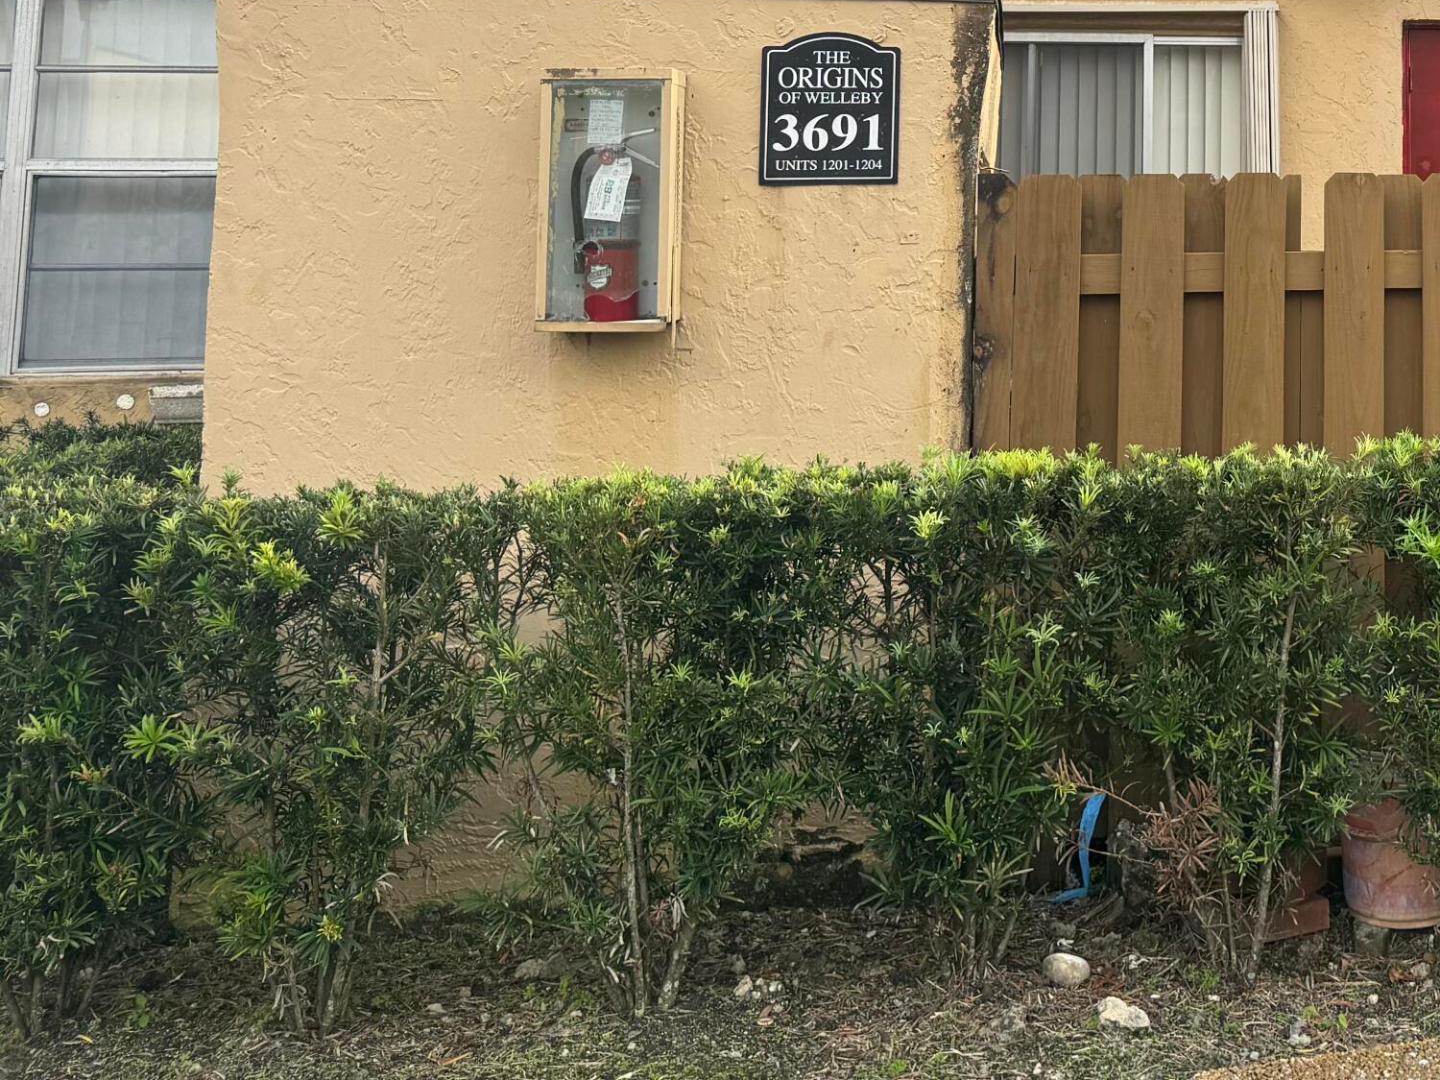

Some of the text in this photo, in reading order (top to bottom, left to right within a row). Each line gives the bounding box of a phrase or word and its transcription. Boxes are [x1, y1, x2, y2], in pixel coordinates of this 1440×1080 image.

[813, 51, 851, 64] THE
[777, 67, 884, 89] ORIGINS
[779, 92, 883, 104] OF WELLEBY
[772, 113, 884, 152] 3691
[775, 159, 882, 170] UNITS 1201-1204
